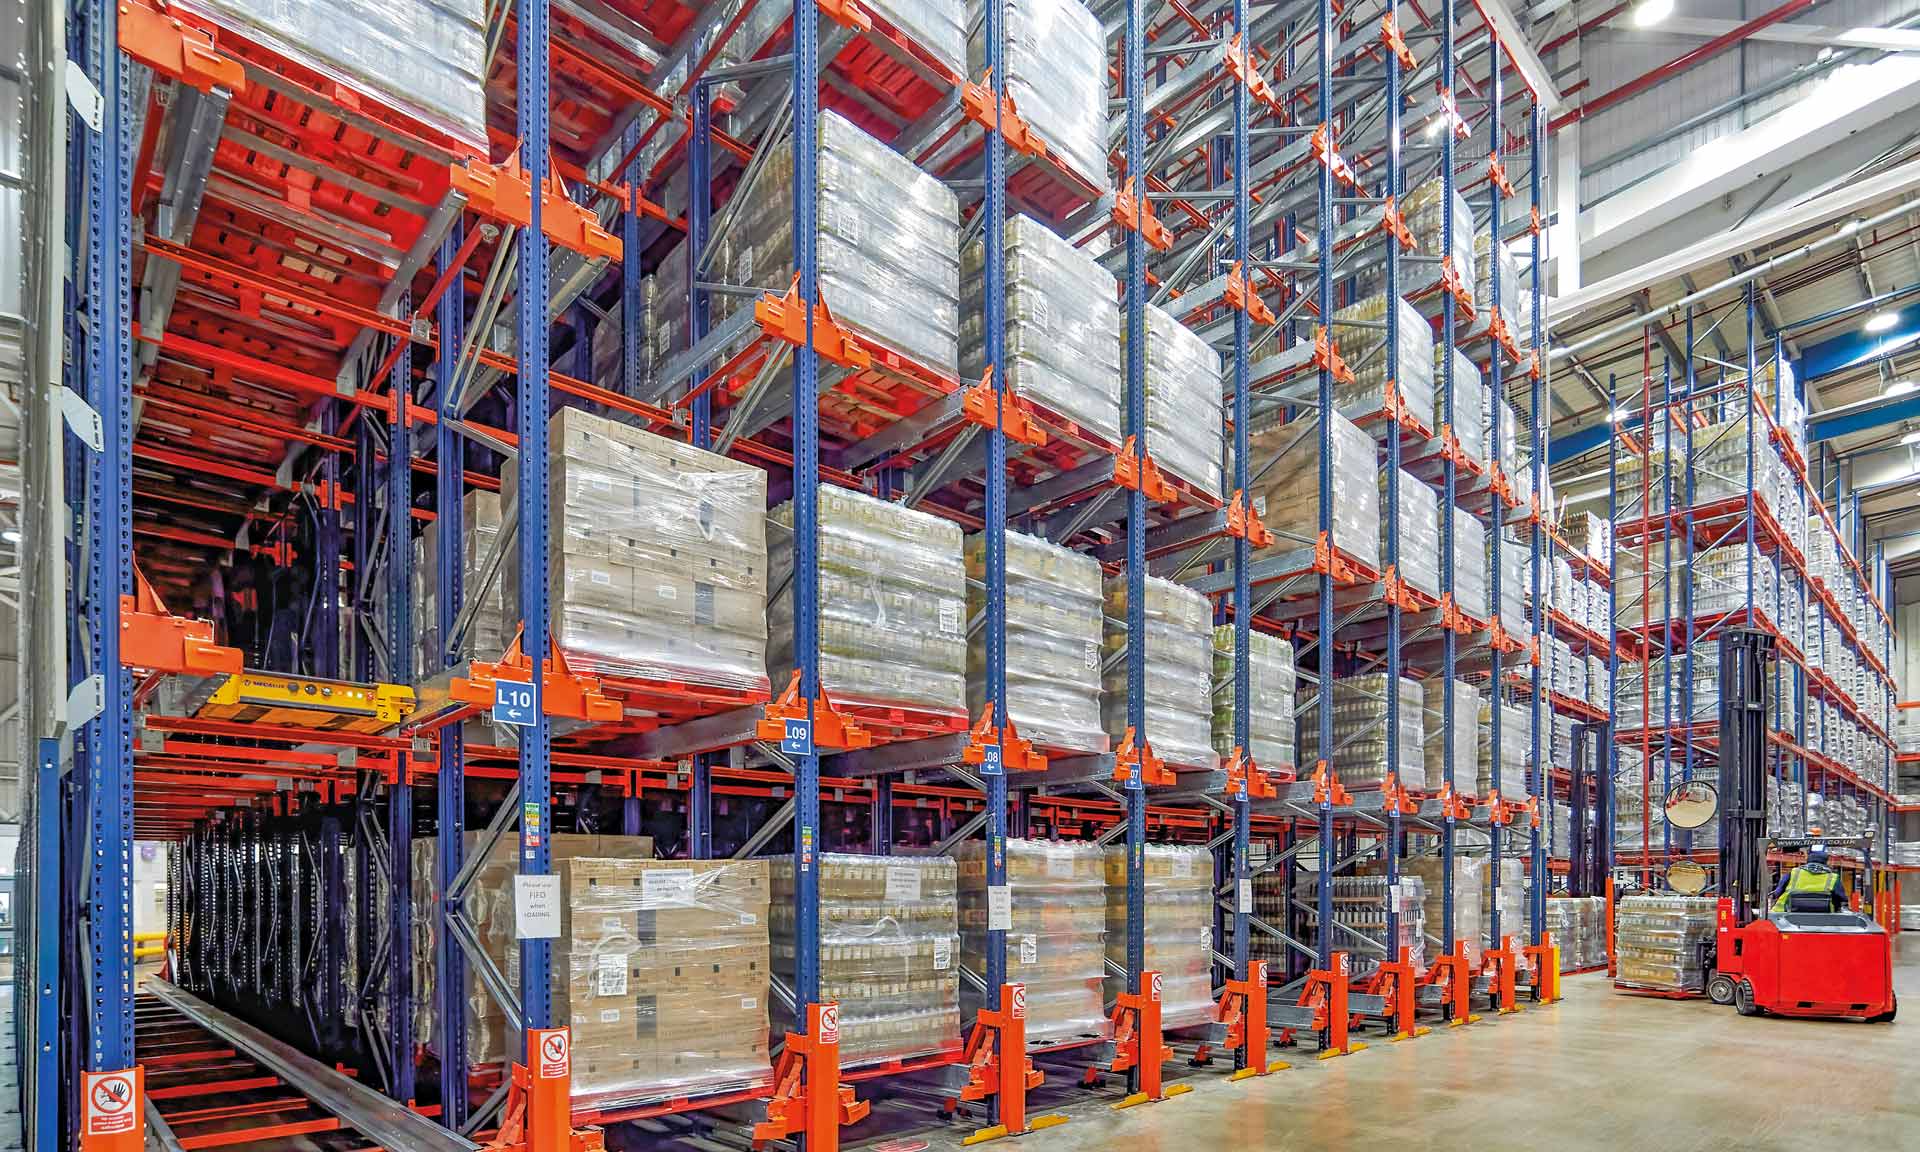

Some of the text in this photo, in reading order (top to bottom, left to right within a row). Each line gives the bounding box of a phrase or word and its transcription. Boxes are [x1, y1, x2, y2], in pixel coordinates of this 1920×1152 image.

[498, 688, 531, 708] L10
[382, 711, 389, 719] 2
[785, 725, 807, 740] L09
[984, 751, 999, 763] 08
